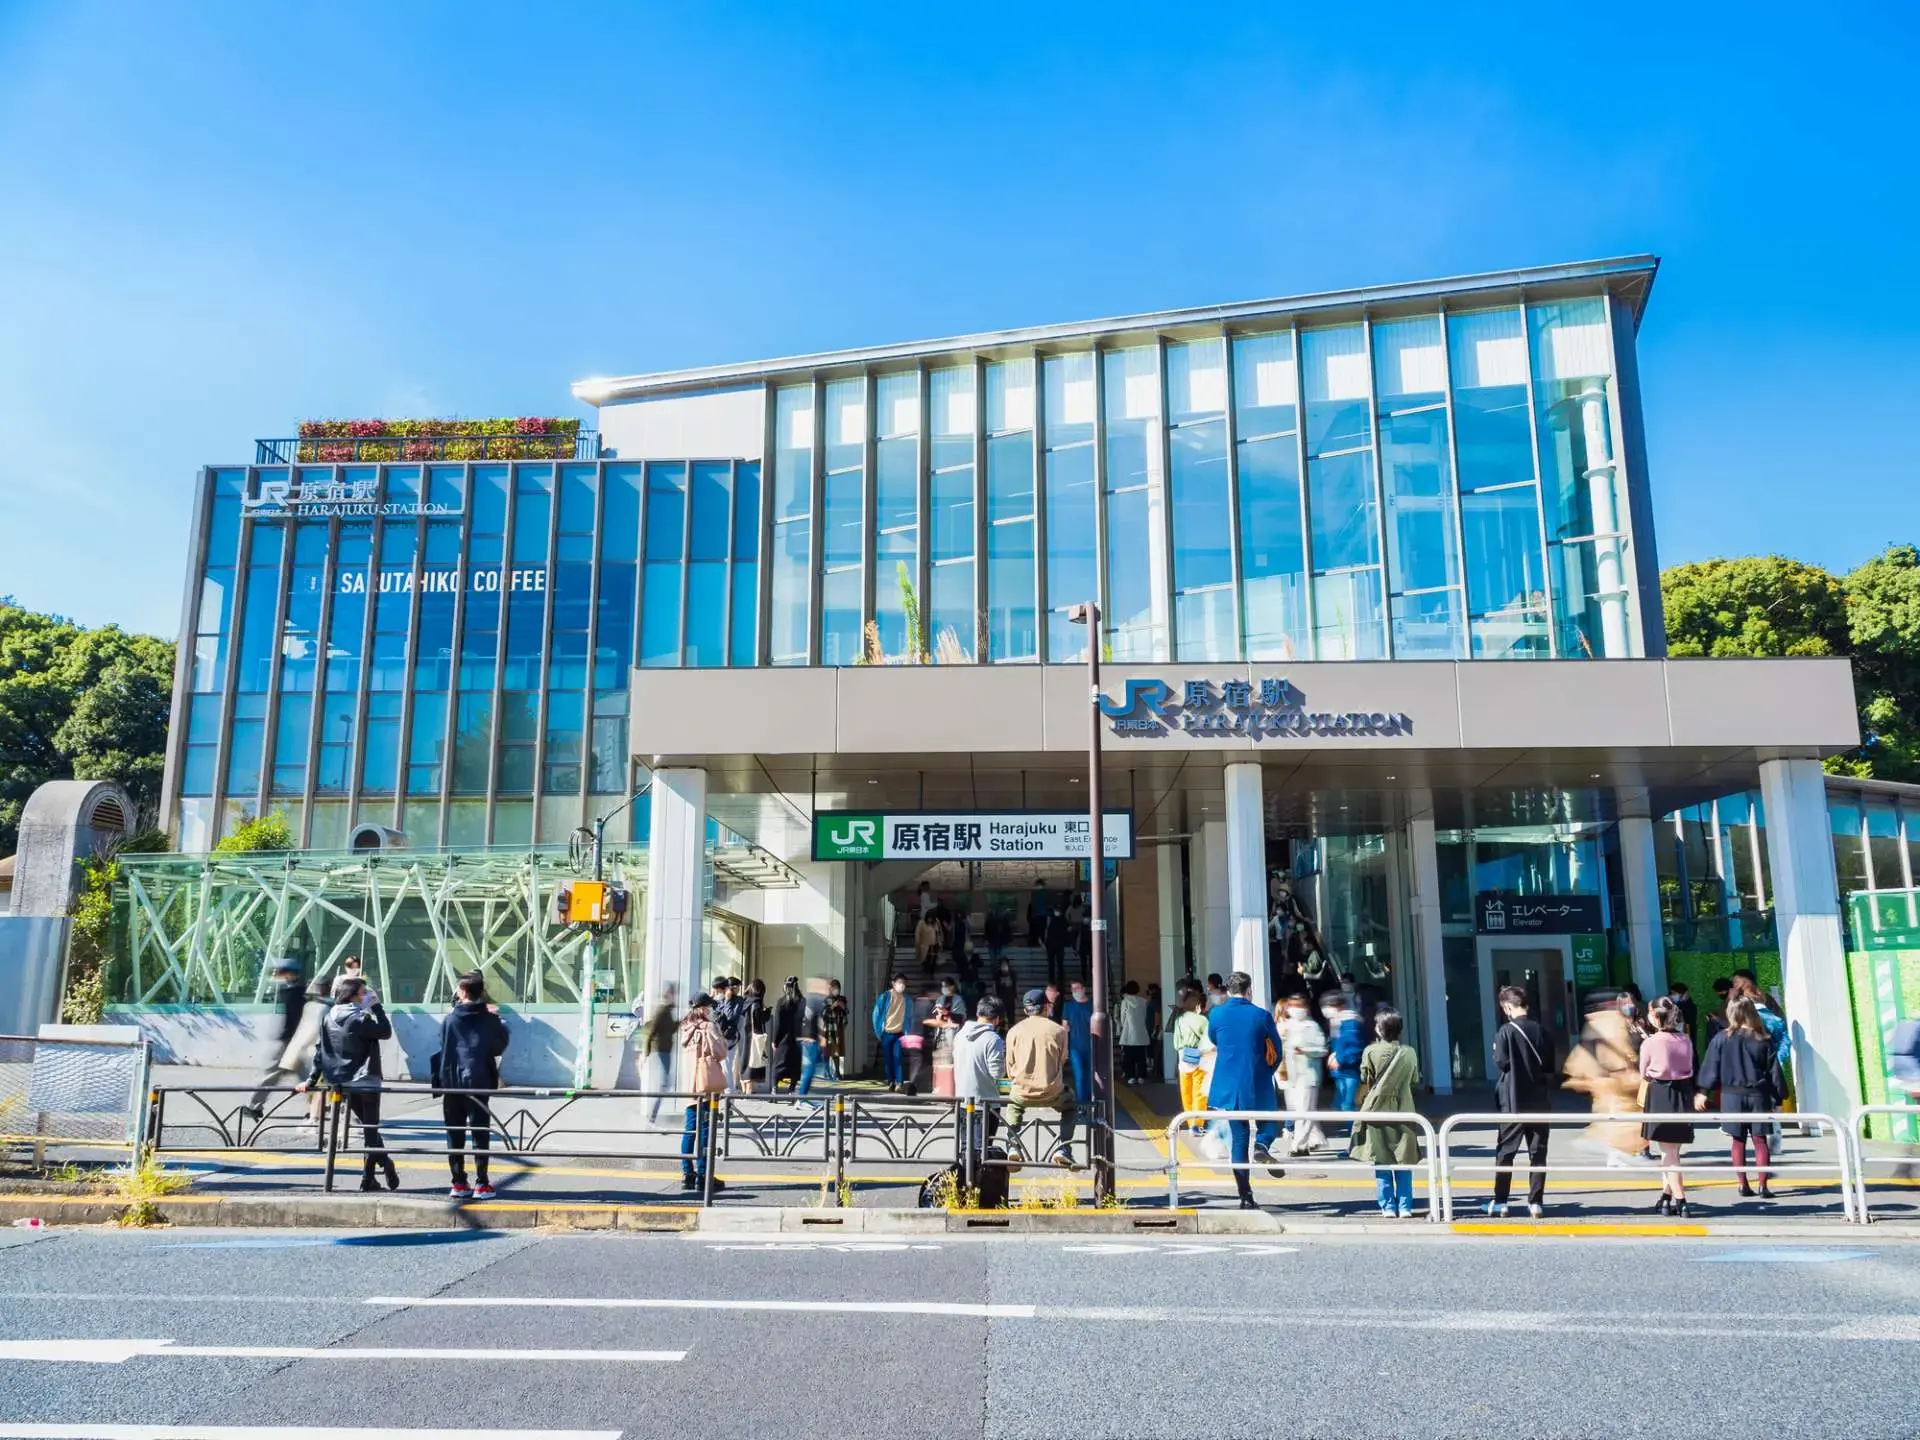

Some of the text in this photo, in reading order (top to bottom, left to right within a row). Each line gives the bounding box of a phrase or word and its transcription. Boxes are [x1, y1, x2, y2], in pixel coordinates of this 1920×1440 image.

[241, 481, 290, 507] JR
[299, 480, 377, 501] 原宿駅
[297, 502, 448, 518] HARAJUKU STATION
[341, 570, 546, 593] SAUTAHIKO COFEE
[1099, 678, 1168, 717] JR
[1183, 679, 1292, 708] 原宿駅
[831, 820, 875, 845] JR
[989, 822, 1057, 837] Harajuku
[1064, 821, 1090, 833] 東口
[892, 823, 982, 851] 原宿駅
[989, 838, 1044, 851] Station
[1064, 835, 1081, 843] East
[836, 846, 870, 854] JR東日本
[1511, 904, 1583, 917] エレベーター
[1513, 918, 1544, 927] Elevator
[1575, 948, 1594, 959] JR
